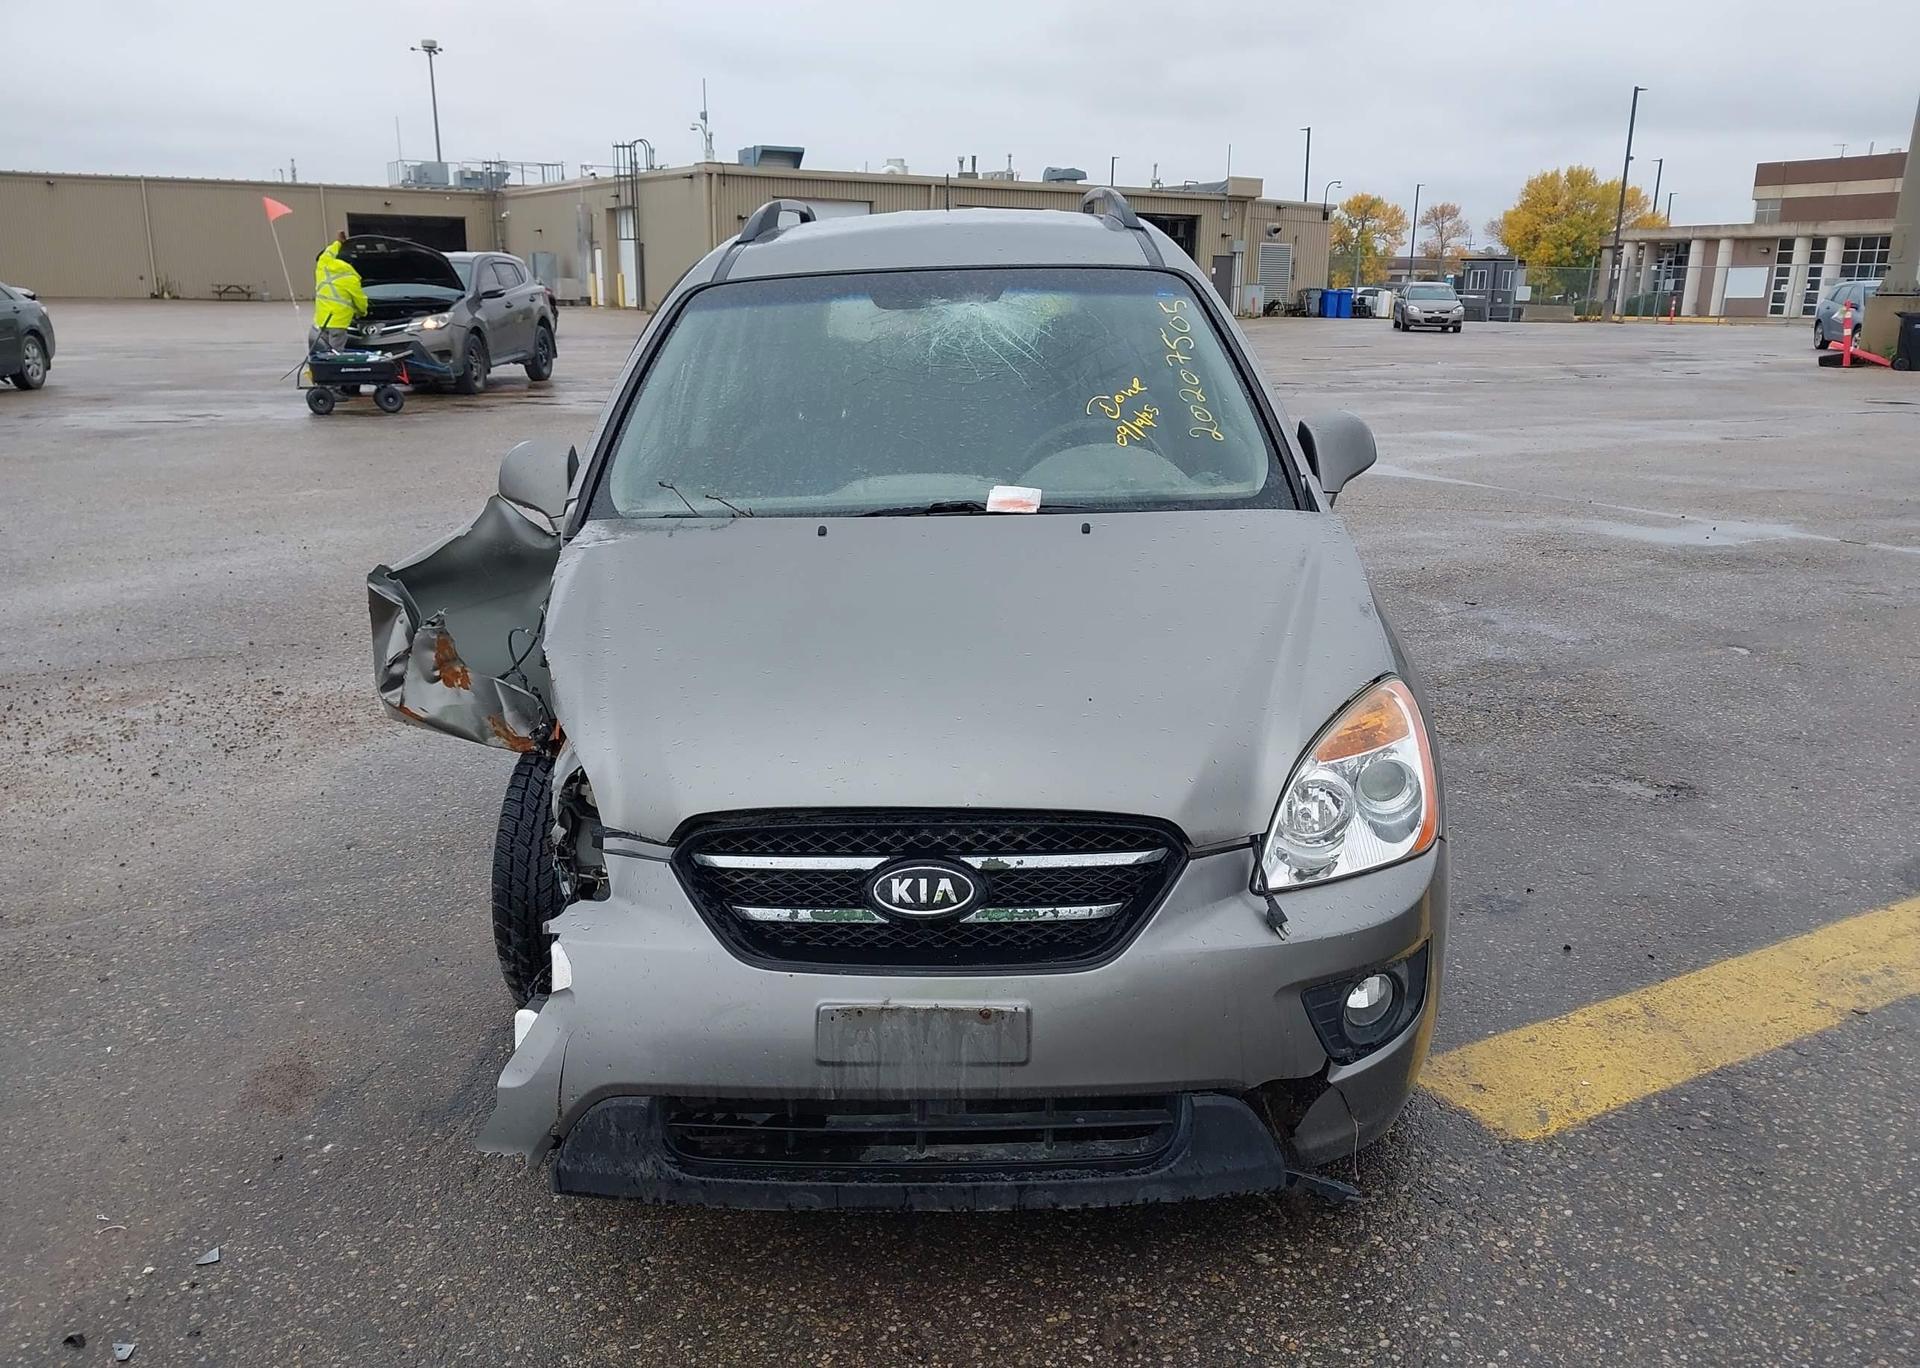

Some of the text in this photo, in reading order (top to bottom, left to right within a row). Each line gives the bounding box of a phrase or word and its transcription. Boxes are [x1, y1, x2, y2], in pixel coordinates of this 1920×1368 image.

[1159, 299, 1225, 442] 20207505
[1086, 376, 1148, 419] Done
[890, 878, 958, 904] KIA
